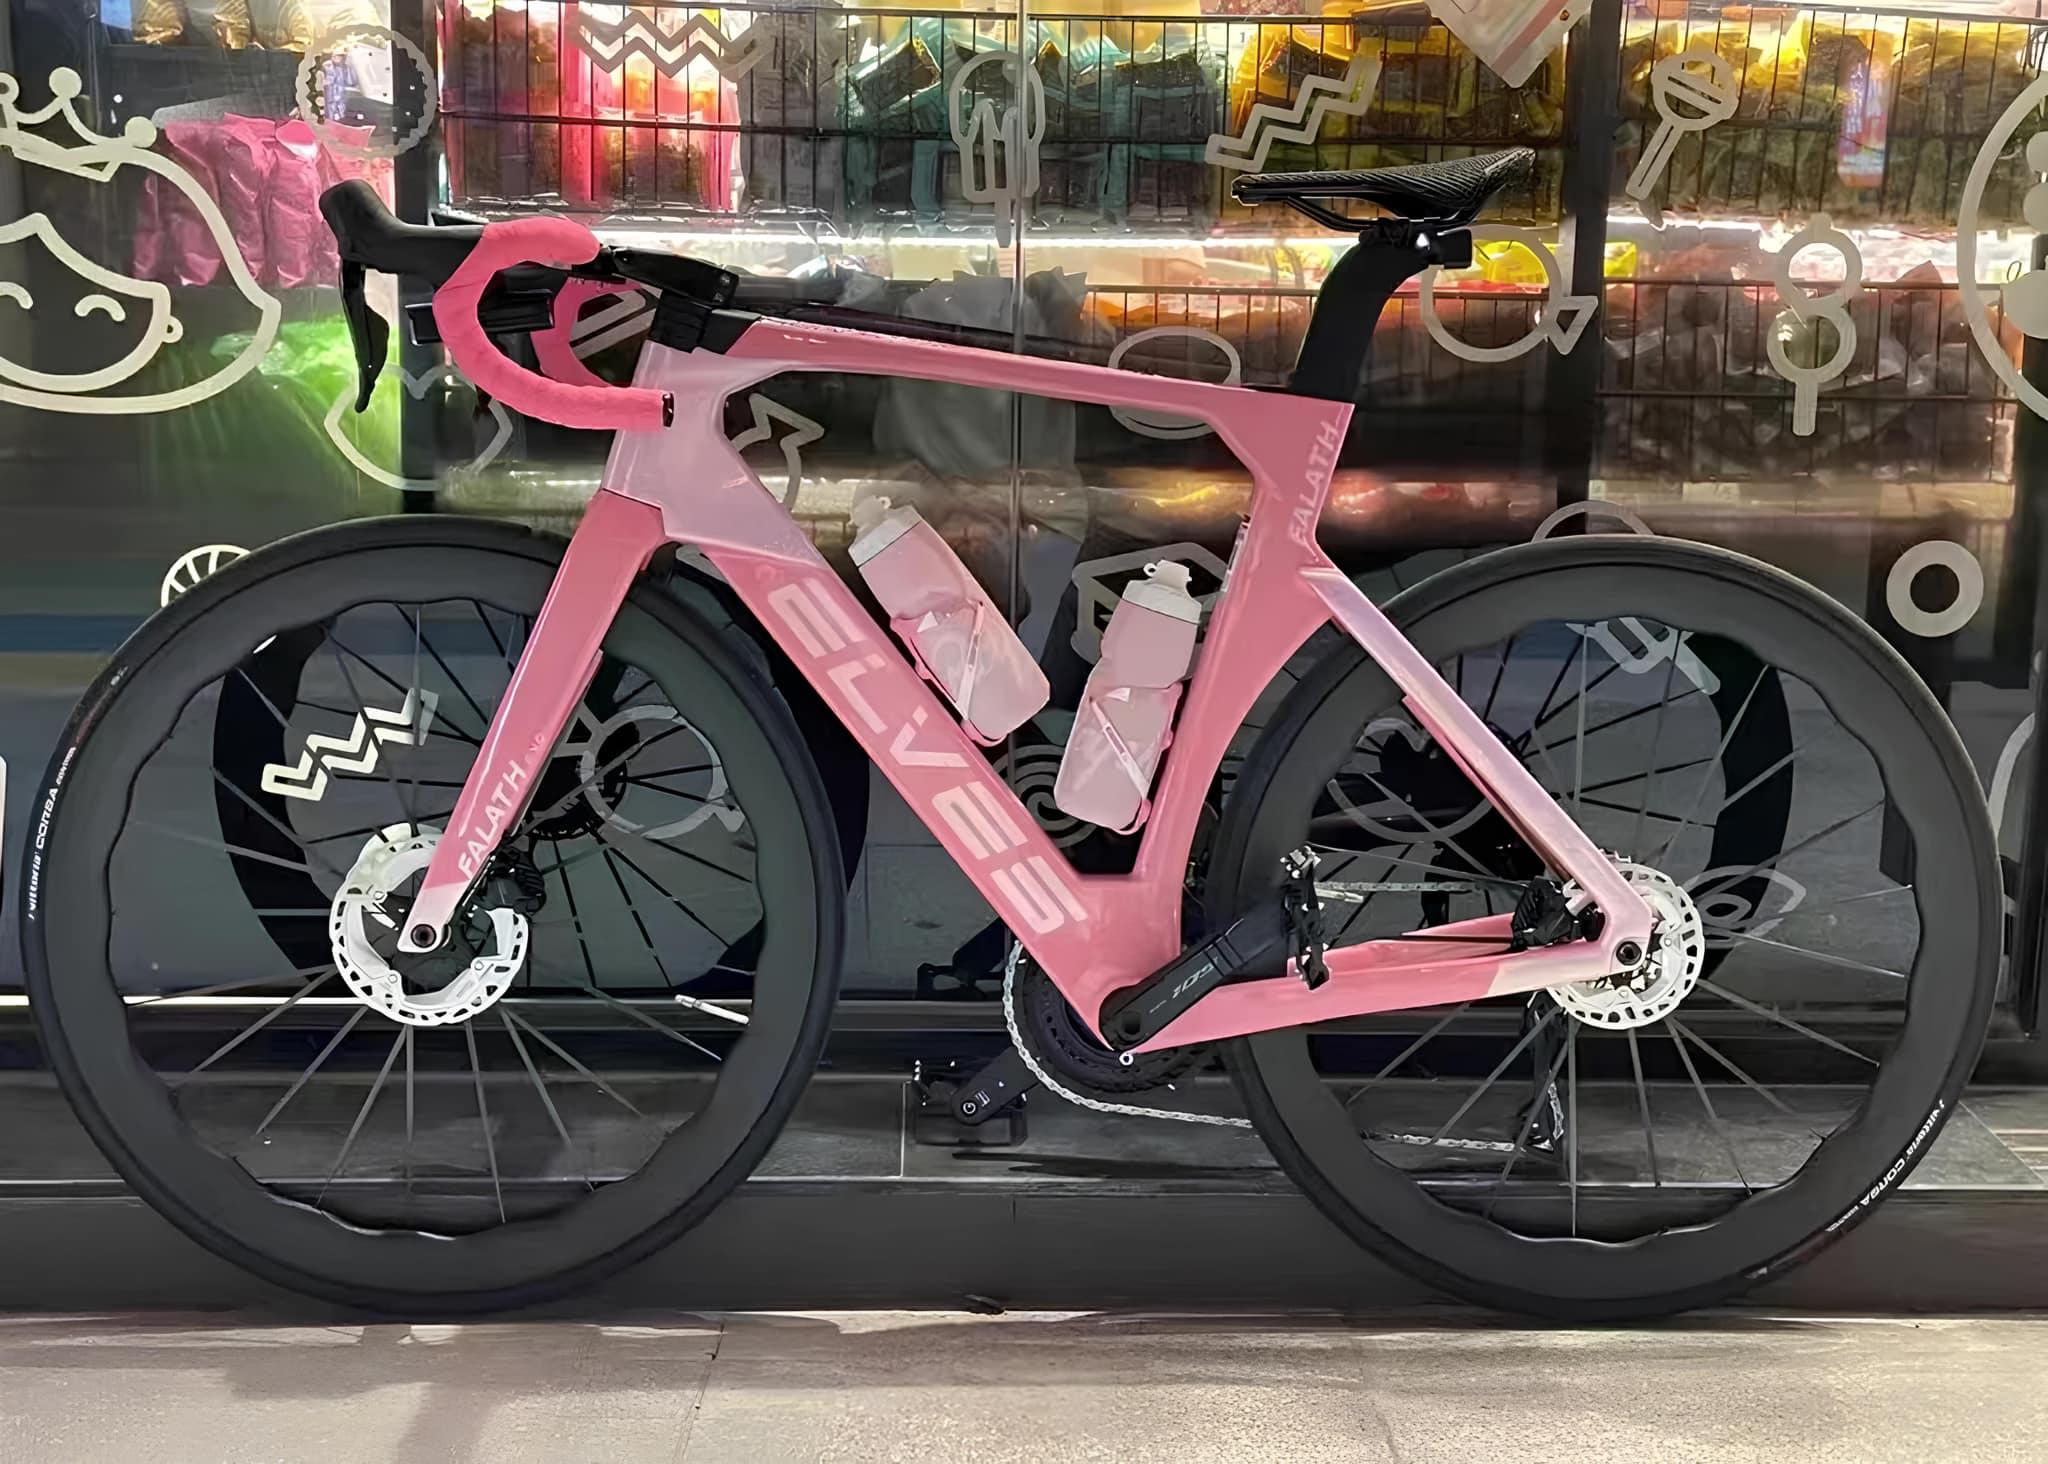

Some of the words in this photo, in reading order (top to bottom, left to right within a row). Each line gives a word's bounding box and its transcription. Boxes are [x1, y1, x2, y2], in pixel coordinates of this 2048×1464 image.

[1288, 420, 1339, 546] FALATH
[768, 577, 1088, 934] ELVES
[458, 759, 527, 880] FALATH
